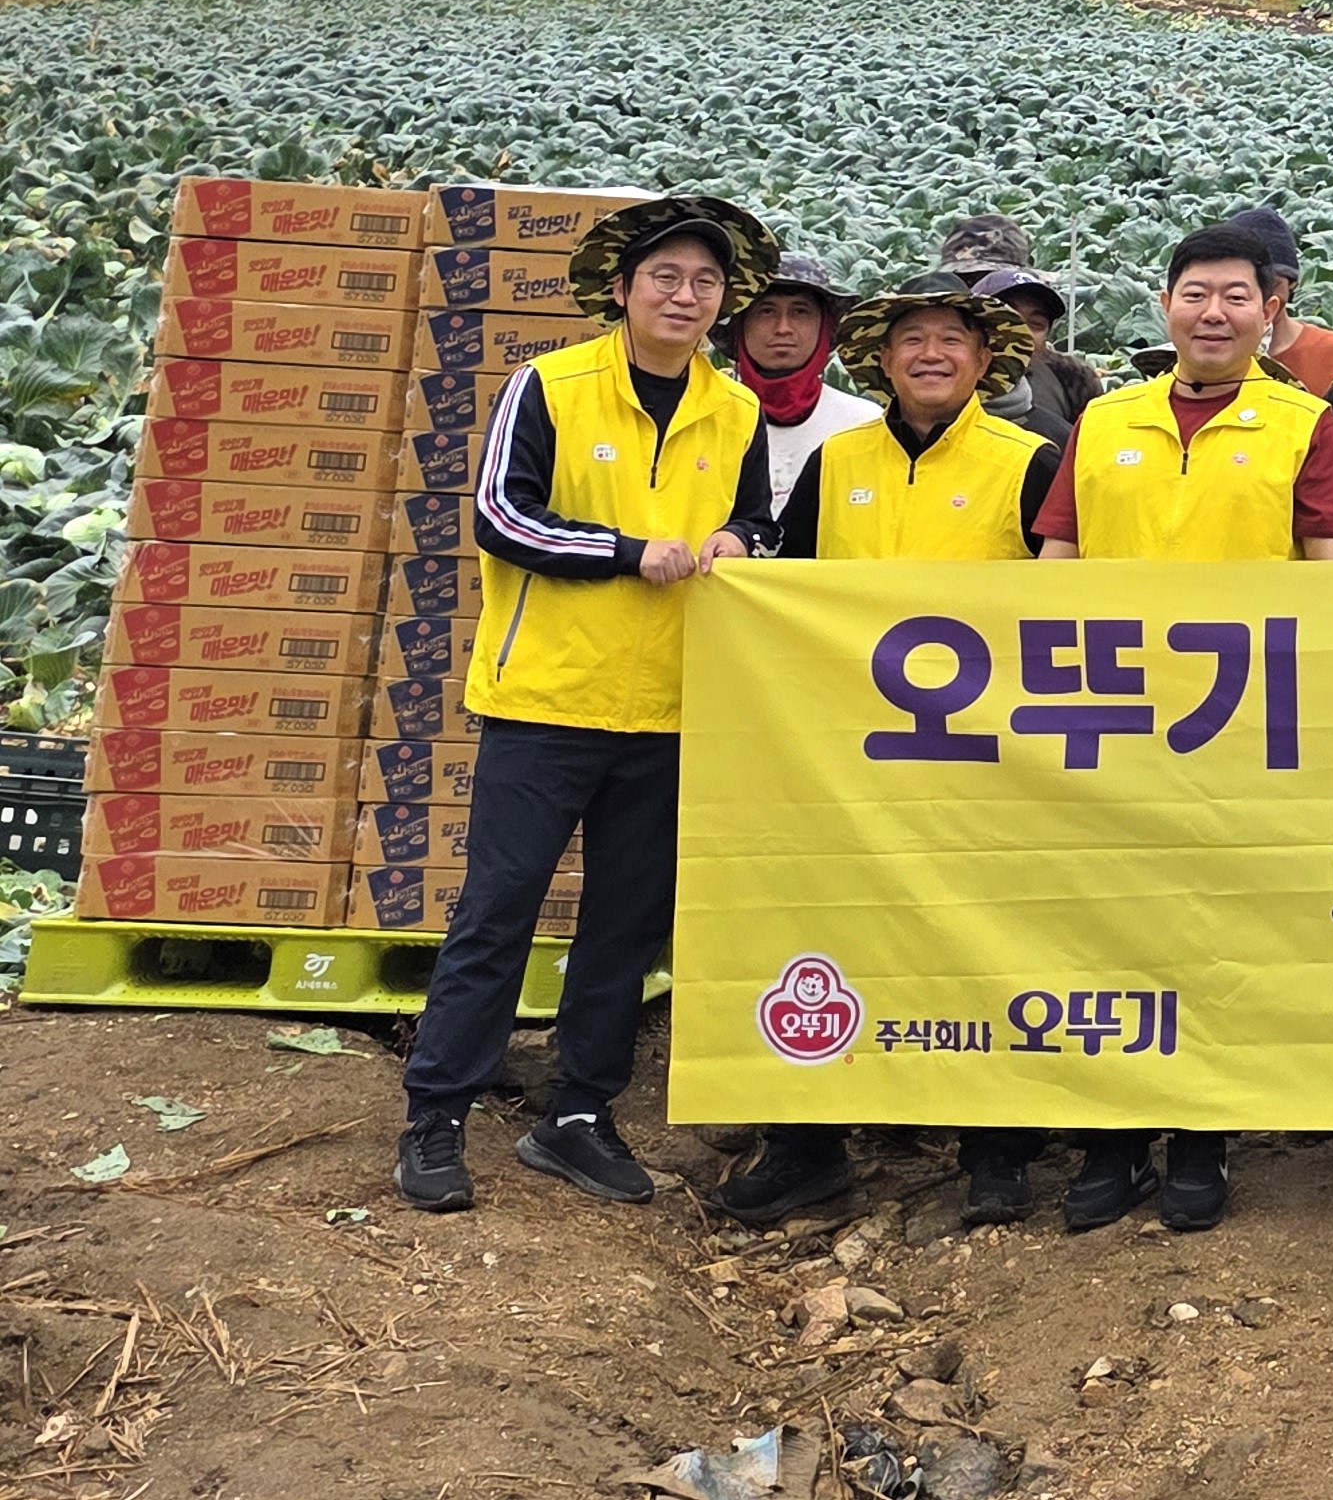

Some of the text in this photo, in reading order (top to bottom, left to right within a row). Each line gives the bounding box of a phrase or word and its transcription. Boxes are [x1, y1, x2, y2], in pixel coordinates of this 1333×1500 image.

[272, 207, 340, 234] 매운맛!
[517, 211, 582, 238] 진한맛!
[260, 264, 327, 292] 매운맛!
[255, 324, 322, 352] 매운맛!
[242, 385, 309, 414] 매운맛!
[230, 444, 298, 472] 매운맛!
[224, 505, 291, 534] 매운맛!
[210, 568, 278, 598] 매운맛!
[202, 631, 269, 661] 매운맛!
[190, 692, 259, 722] 매운맛!
[863, 615, 1299, 770] 오뚜기
[184, 754, 254, 785] 매운맛!
[178, 882, 247, 913] 매운맛!
[779, 1013, 840, 1039] 오뚜기
[875, 990, 1178, 1056] 주식회사 오뚜기
